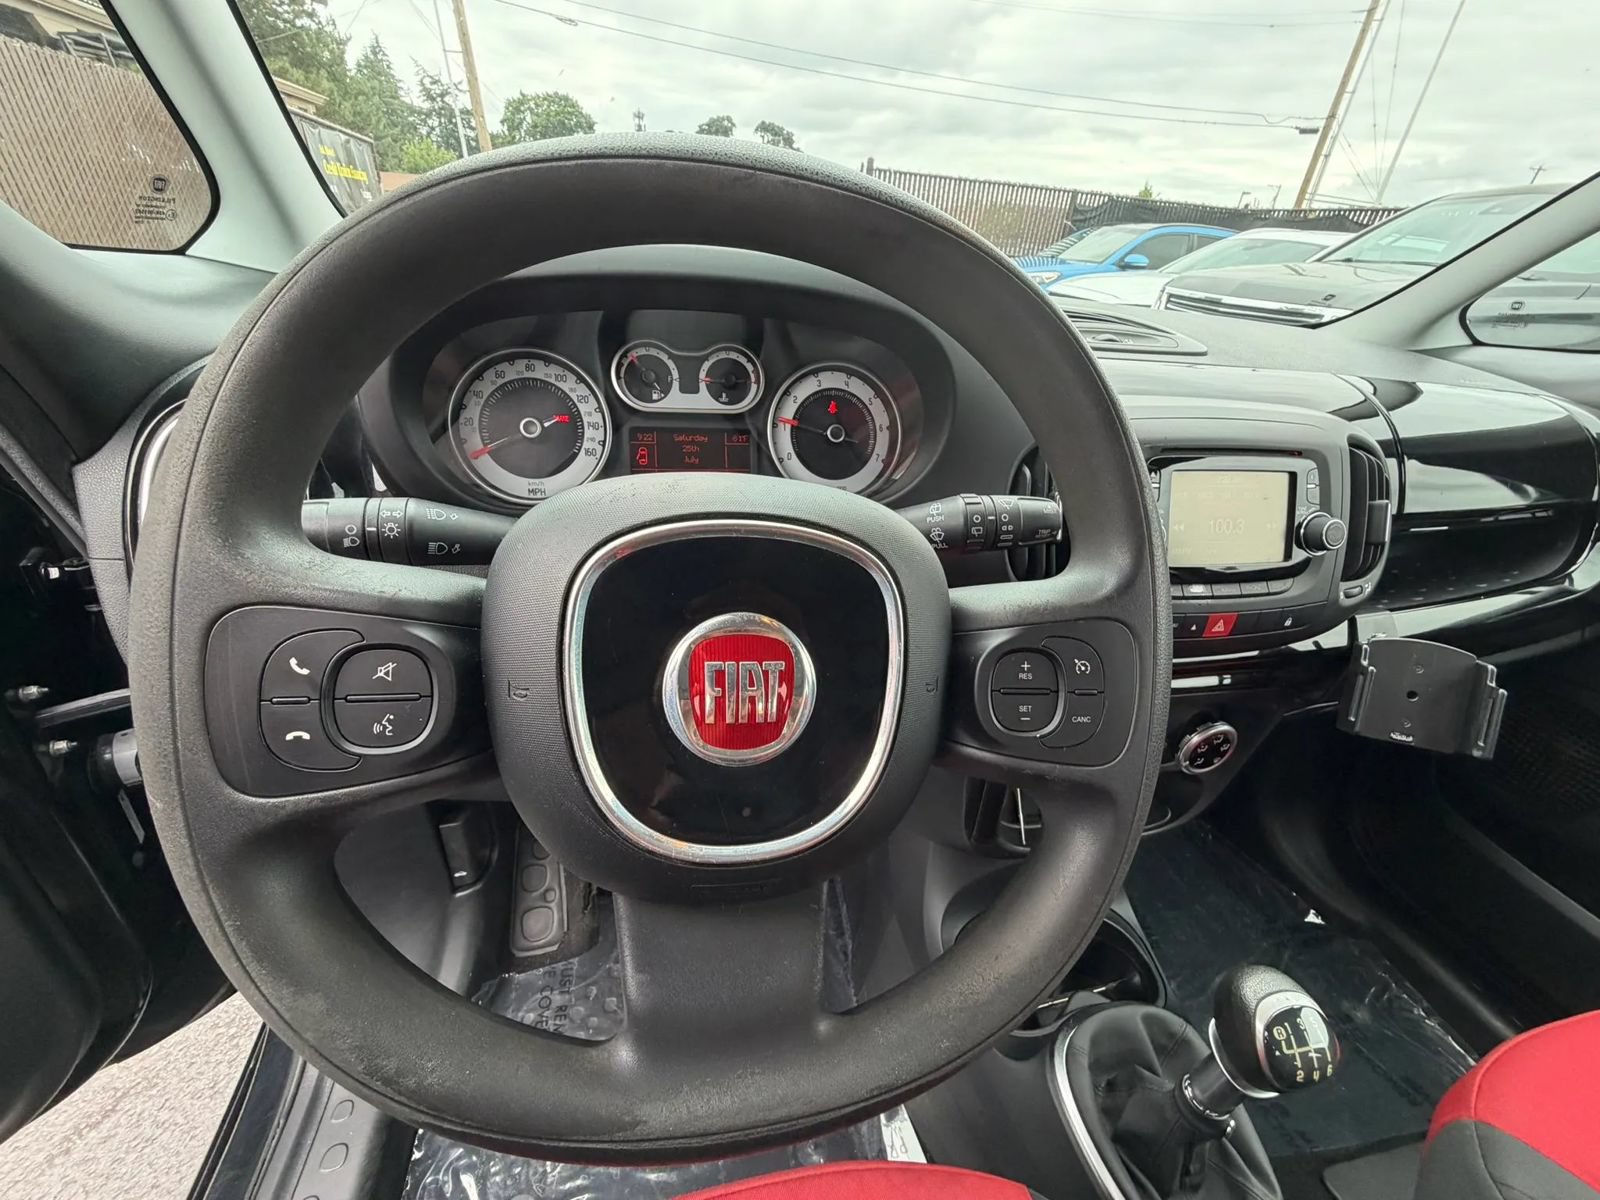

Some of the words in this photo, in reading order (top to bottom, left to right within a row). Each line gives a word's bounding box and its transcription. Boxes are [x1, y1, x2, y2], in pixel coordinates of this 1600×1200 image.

[524, 363, 536, 372] 80
[494, 370, 506, 379] 60
[554, 374, 567, 383] 100
[473, 390, 483, 399] 40
[576, 394, 589, 404] 120
[464, 417, 473, 426] 20
[587, 422, 599, 430] 140
[878, 424, 884, 432] 6
[673, 433, 708, 443] Saturday
[584, 448, 597, 456] 160
[787, 452, 792, 460] 0
[875, 453, 880, 462] 7
[528, 488, 546, 496] MPH
[926, 515, 945, 523] PUSH
[1208, 519, 1246, 535] 100.3
[704, 661, 786, 724] FIAT
[1296, 1018, 1305, 1030] 3
[1327, 1064, 1332, 1076] 6
[1296, 1070, 1304, 1082] 2
[1313, 1070, 1319, 1082] 4
